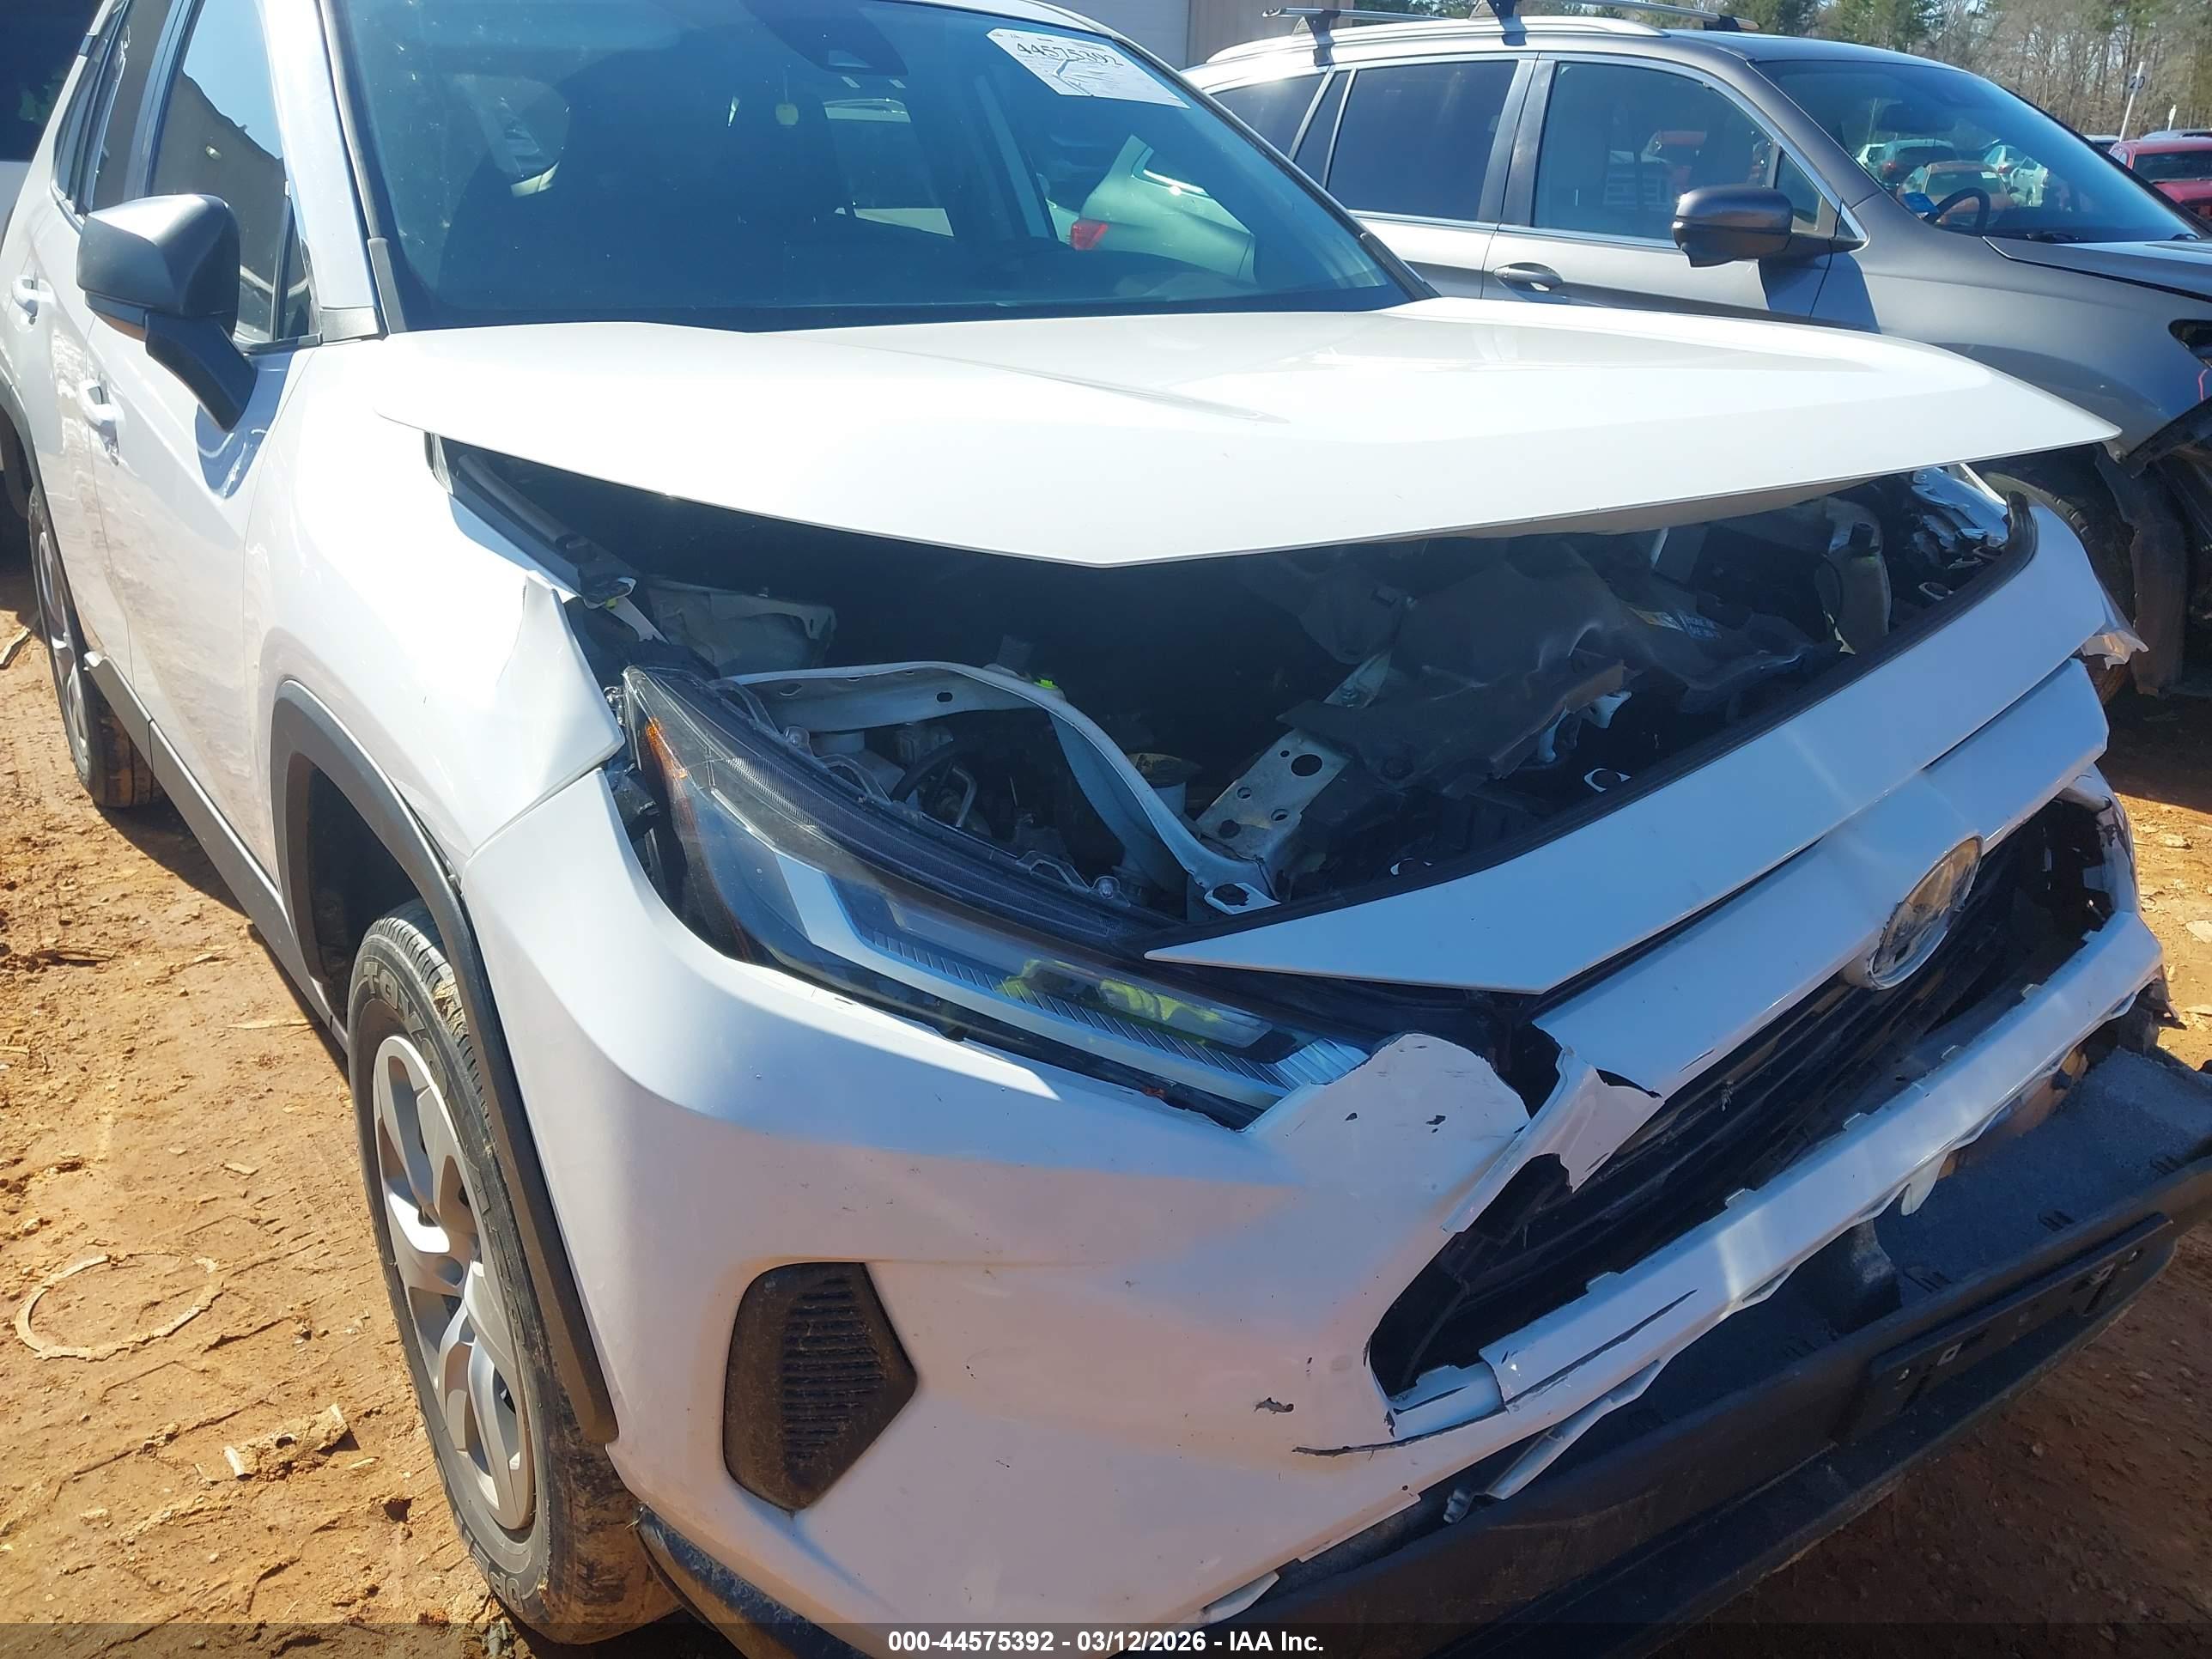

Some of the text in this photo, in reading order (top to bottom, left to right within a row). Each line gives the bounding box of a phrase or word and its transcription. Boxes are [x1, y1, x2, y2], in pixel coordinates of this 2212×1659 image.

[1016, 41, 1125, 67] 44575392
[2129, 75, 2146, 90] 20
[363, 961, 448, 1098] TOYO
